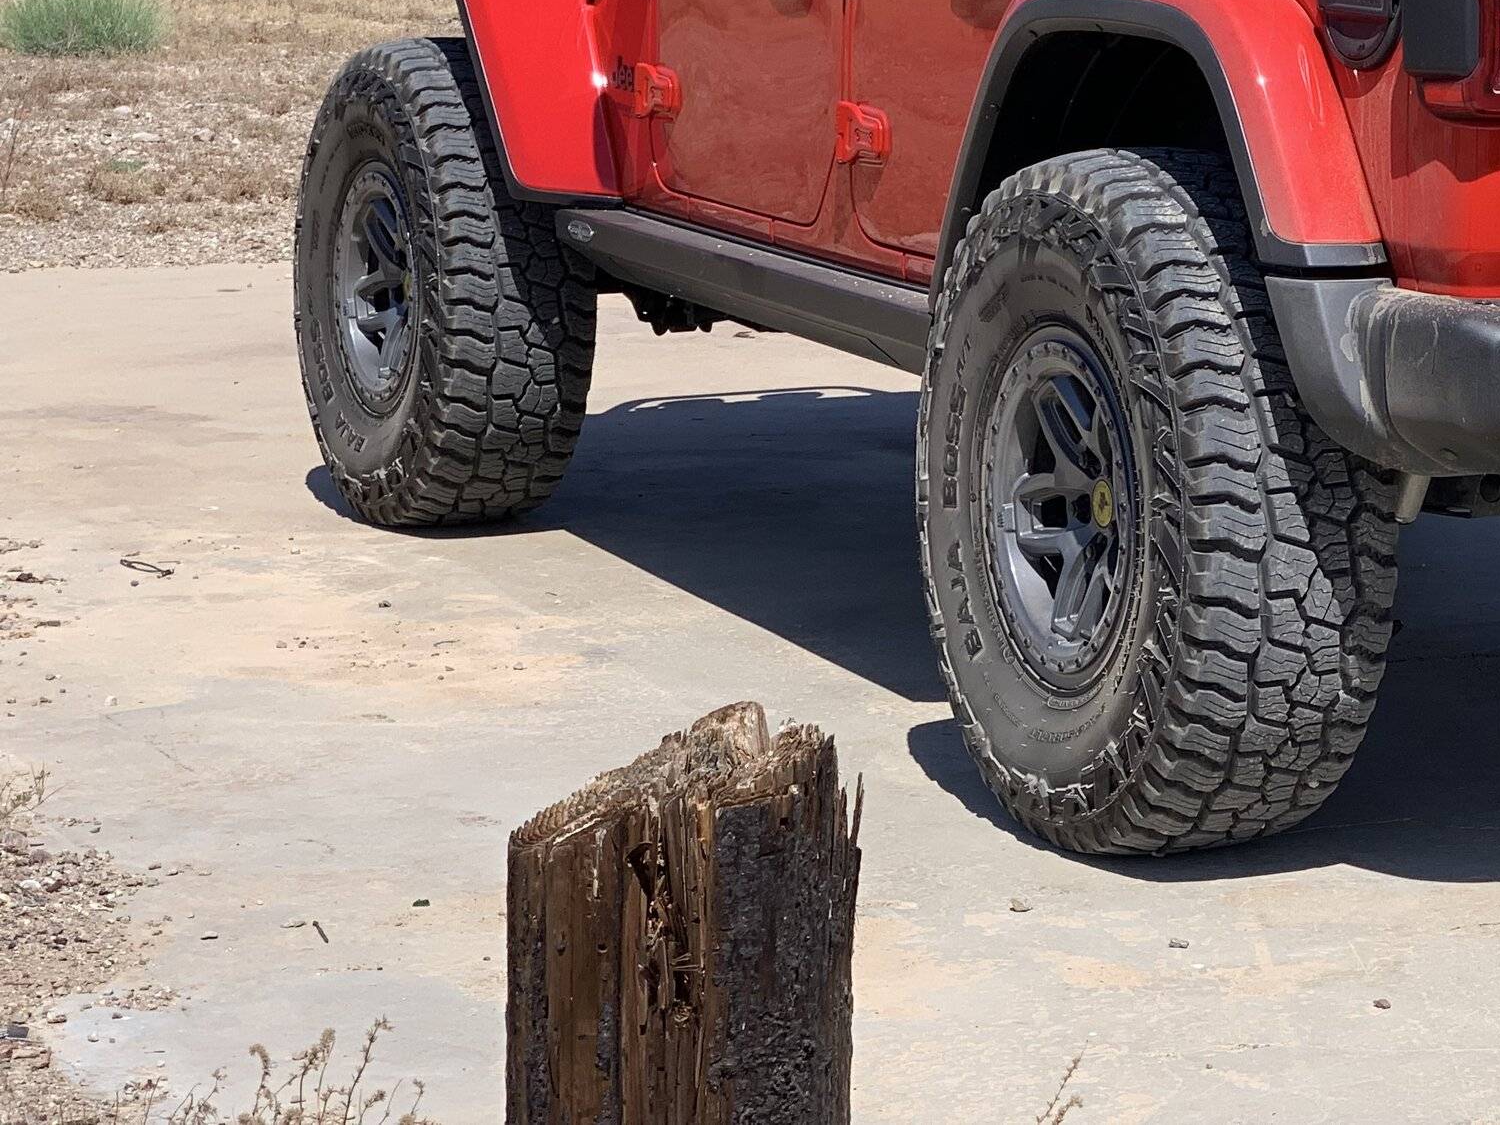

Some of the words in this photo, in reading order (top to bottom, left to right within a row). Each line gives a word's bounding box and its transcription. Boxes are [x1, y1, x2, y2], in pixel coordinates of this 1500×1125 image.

[612, 55, 635, 92] Jee
[942, 382, 968, 509] BOSS
[946, 539, 984, 661] BAJA
